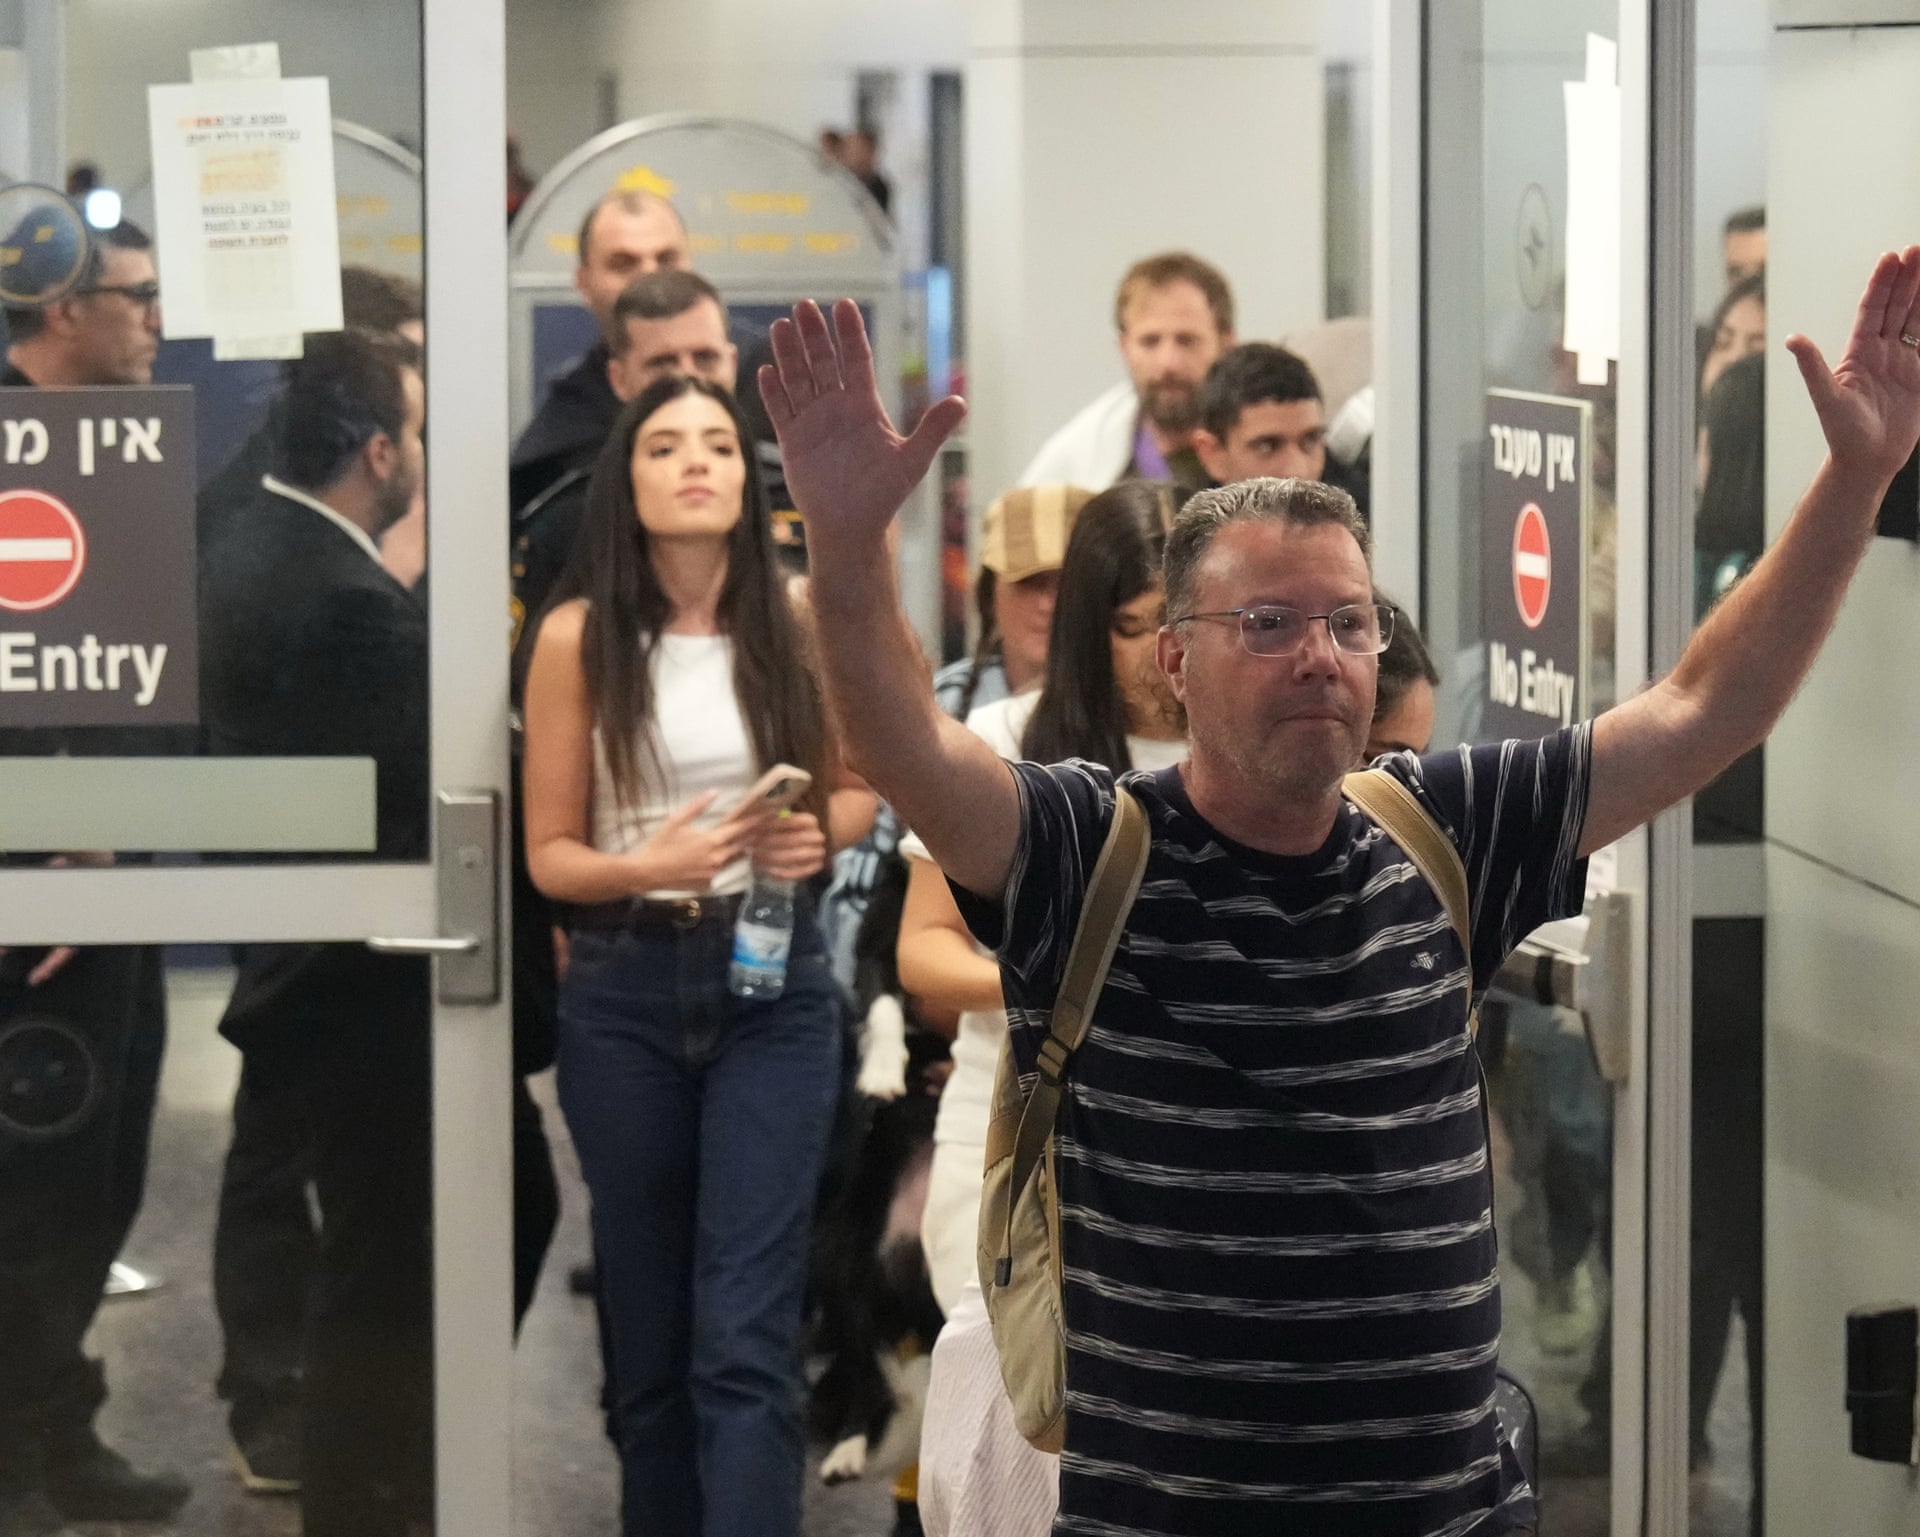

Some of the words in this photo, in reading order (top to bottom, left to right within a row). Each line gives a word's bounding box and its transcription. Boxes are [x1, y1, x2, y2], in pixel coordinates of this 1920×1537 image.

[3, 417, 50, 465] מ
[78, 416, 163, 476] אין
[1489, 423, 1542, 480] מעבר
[1546, 432, 1576, 493] אין
[0, 631, 168, 706] Entry
[1489, 641, 1518, 708] No
[1520, 648, 1575, 729] Entry
